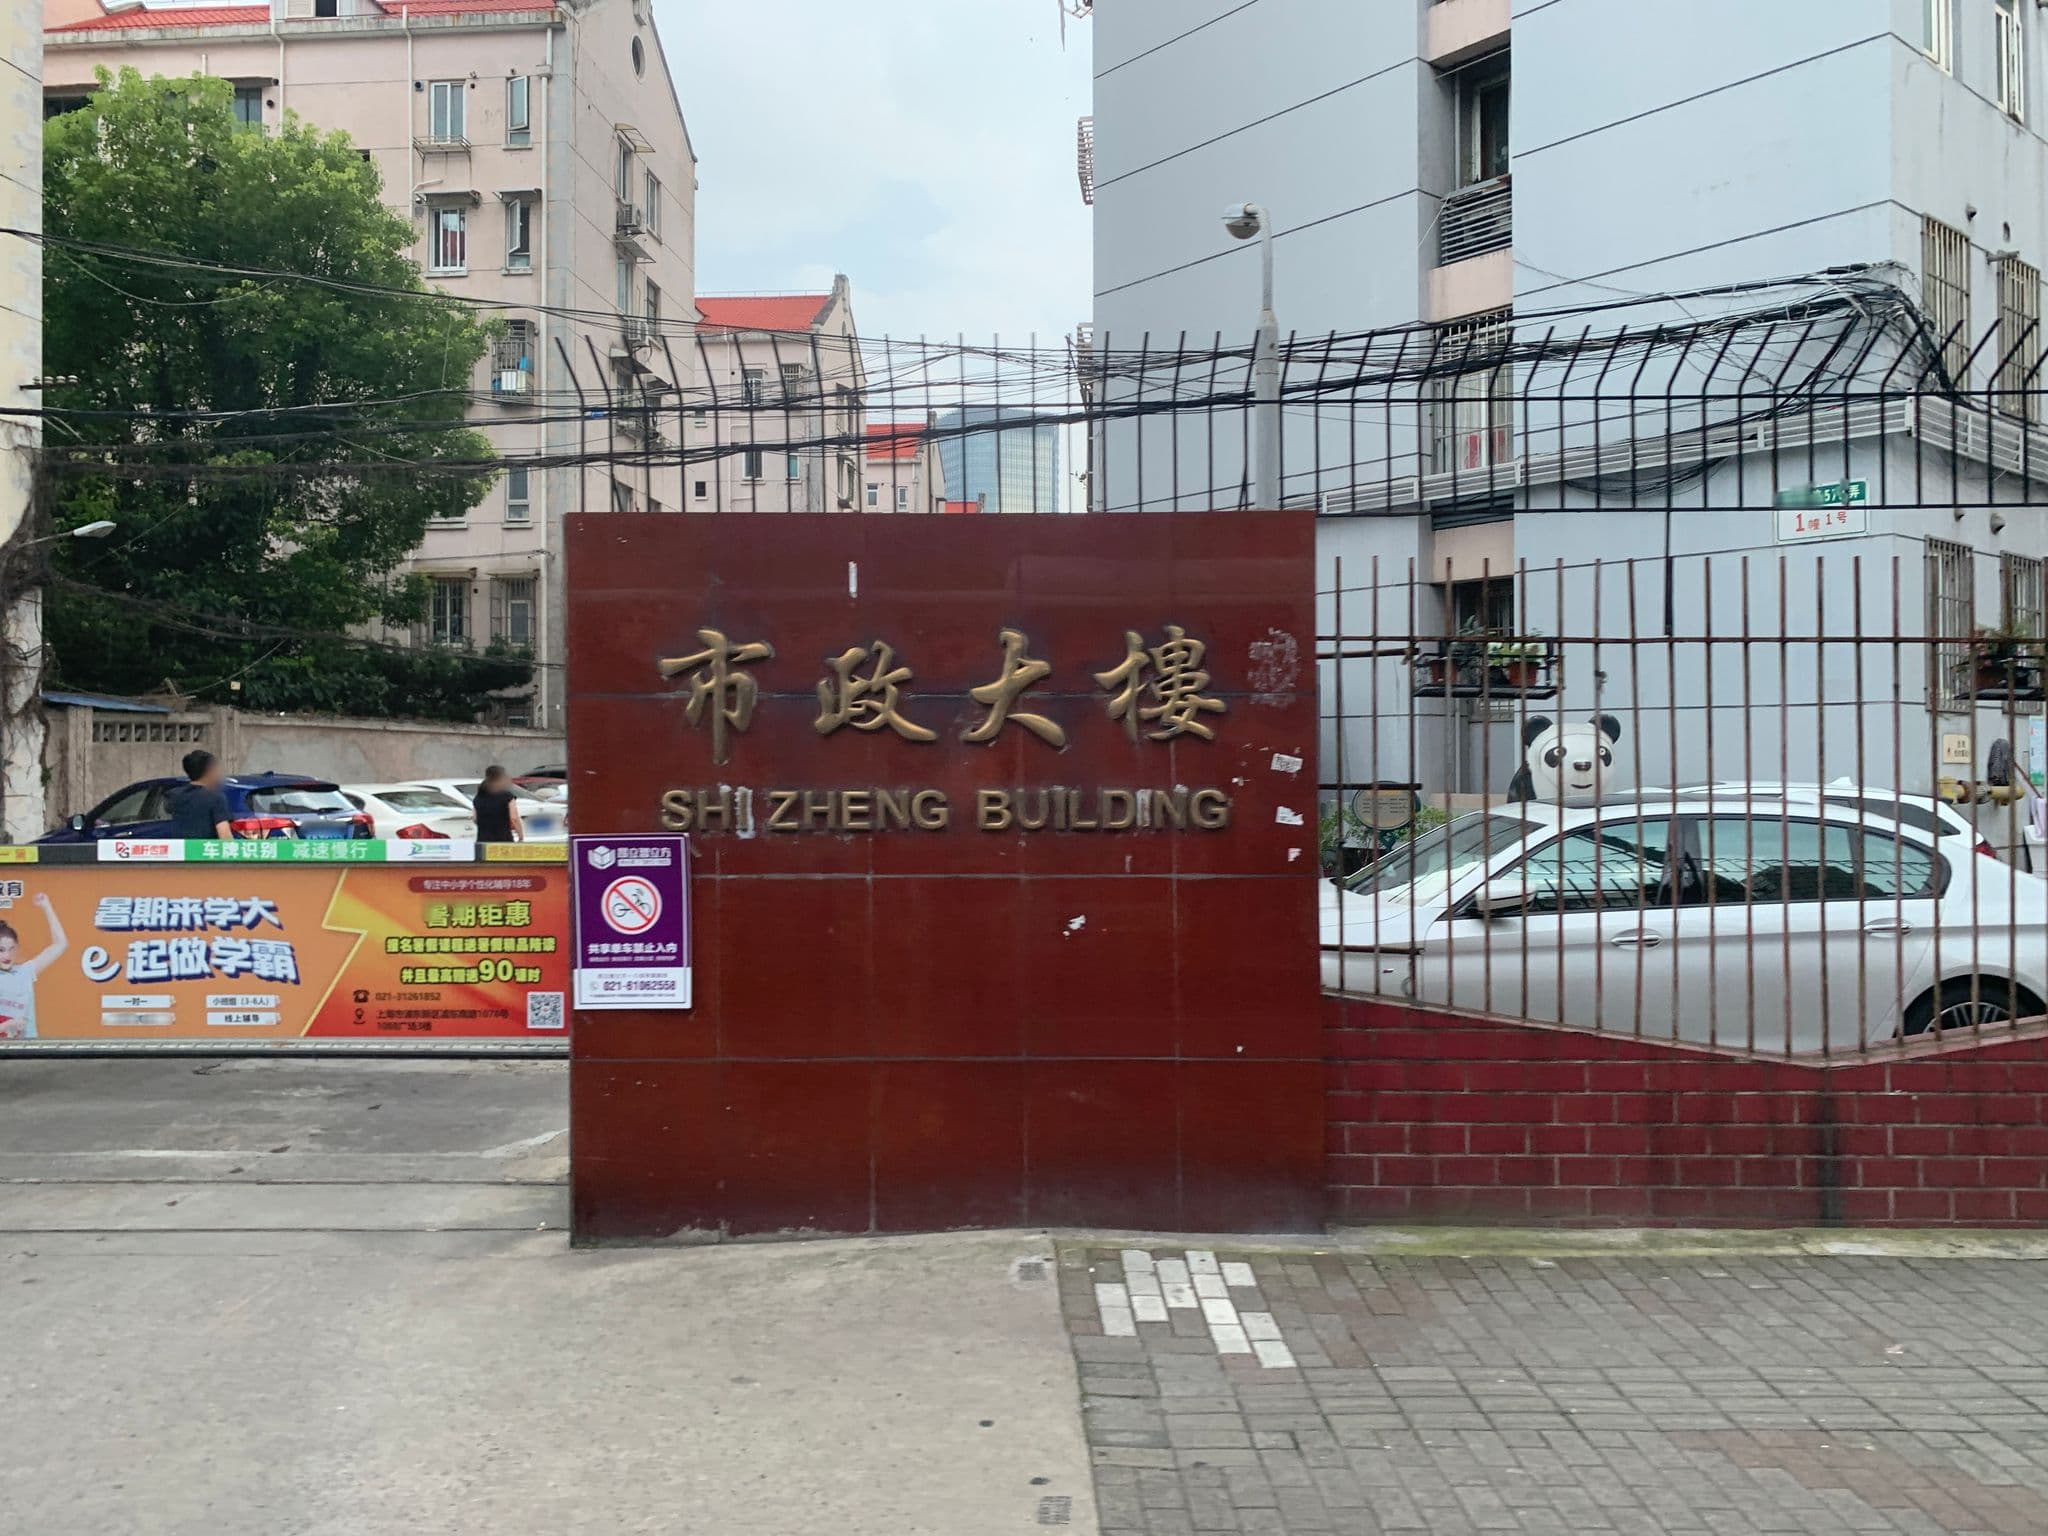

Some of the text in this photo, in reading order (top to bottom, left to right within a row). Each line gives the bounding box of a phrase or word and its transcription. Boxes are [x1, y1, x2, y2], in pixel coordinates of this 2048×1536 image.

[657, 624, 1228, 764] 市政大樓
[977, 787, 1229, 831] BUILDING
[203, 841, 368, 859] 车牌识别 减速慢行
[95, 897, 284, 931] 暑期来学大
